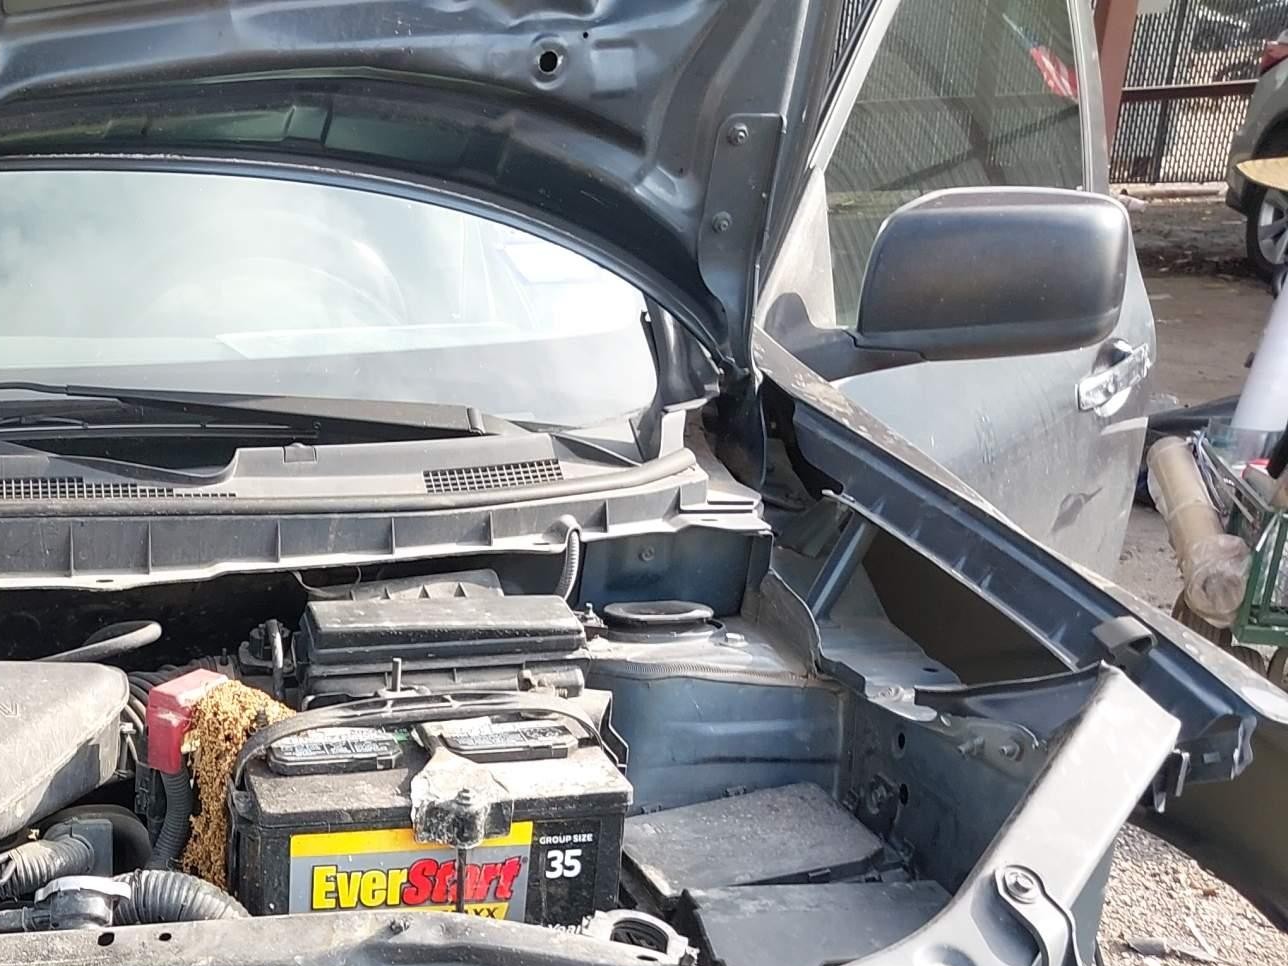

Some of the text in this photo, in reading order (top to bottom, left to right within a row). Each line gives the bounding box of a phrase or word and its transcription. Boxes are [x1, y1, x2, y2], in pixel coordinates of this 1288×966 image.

[539, 833, 593, 845] GROUP SIZE
[545, 849, 582, 878] 35
